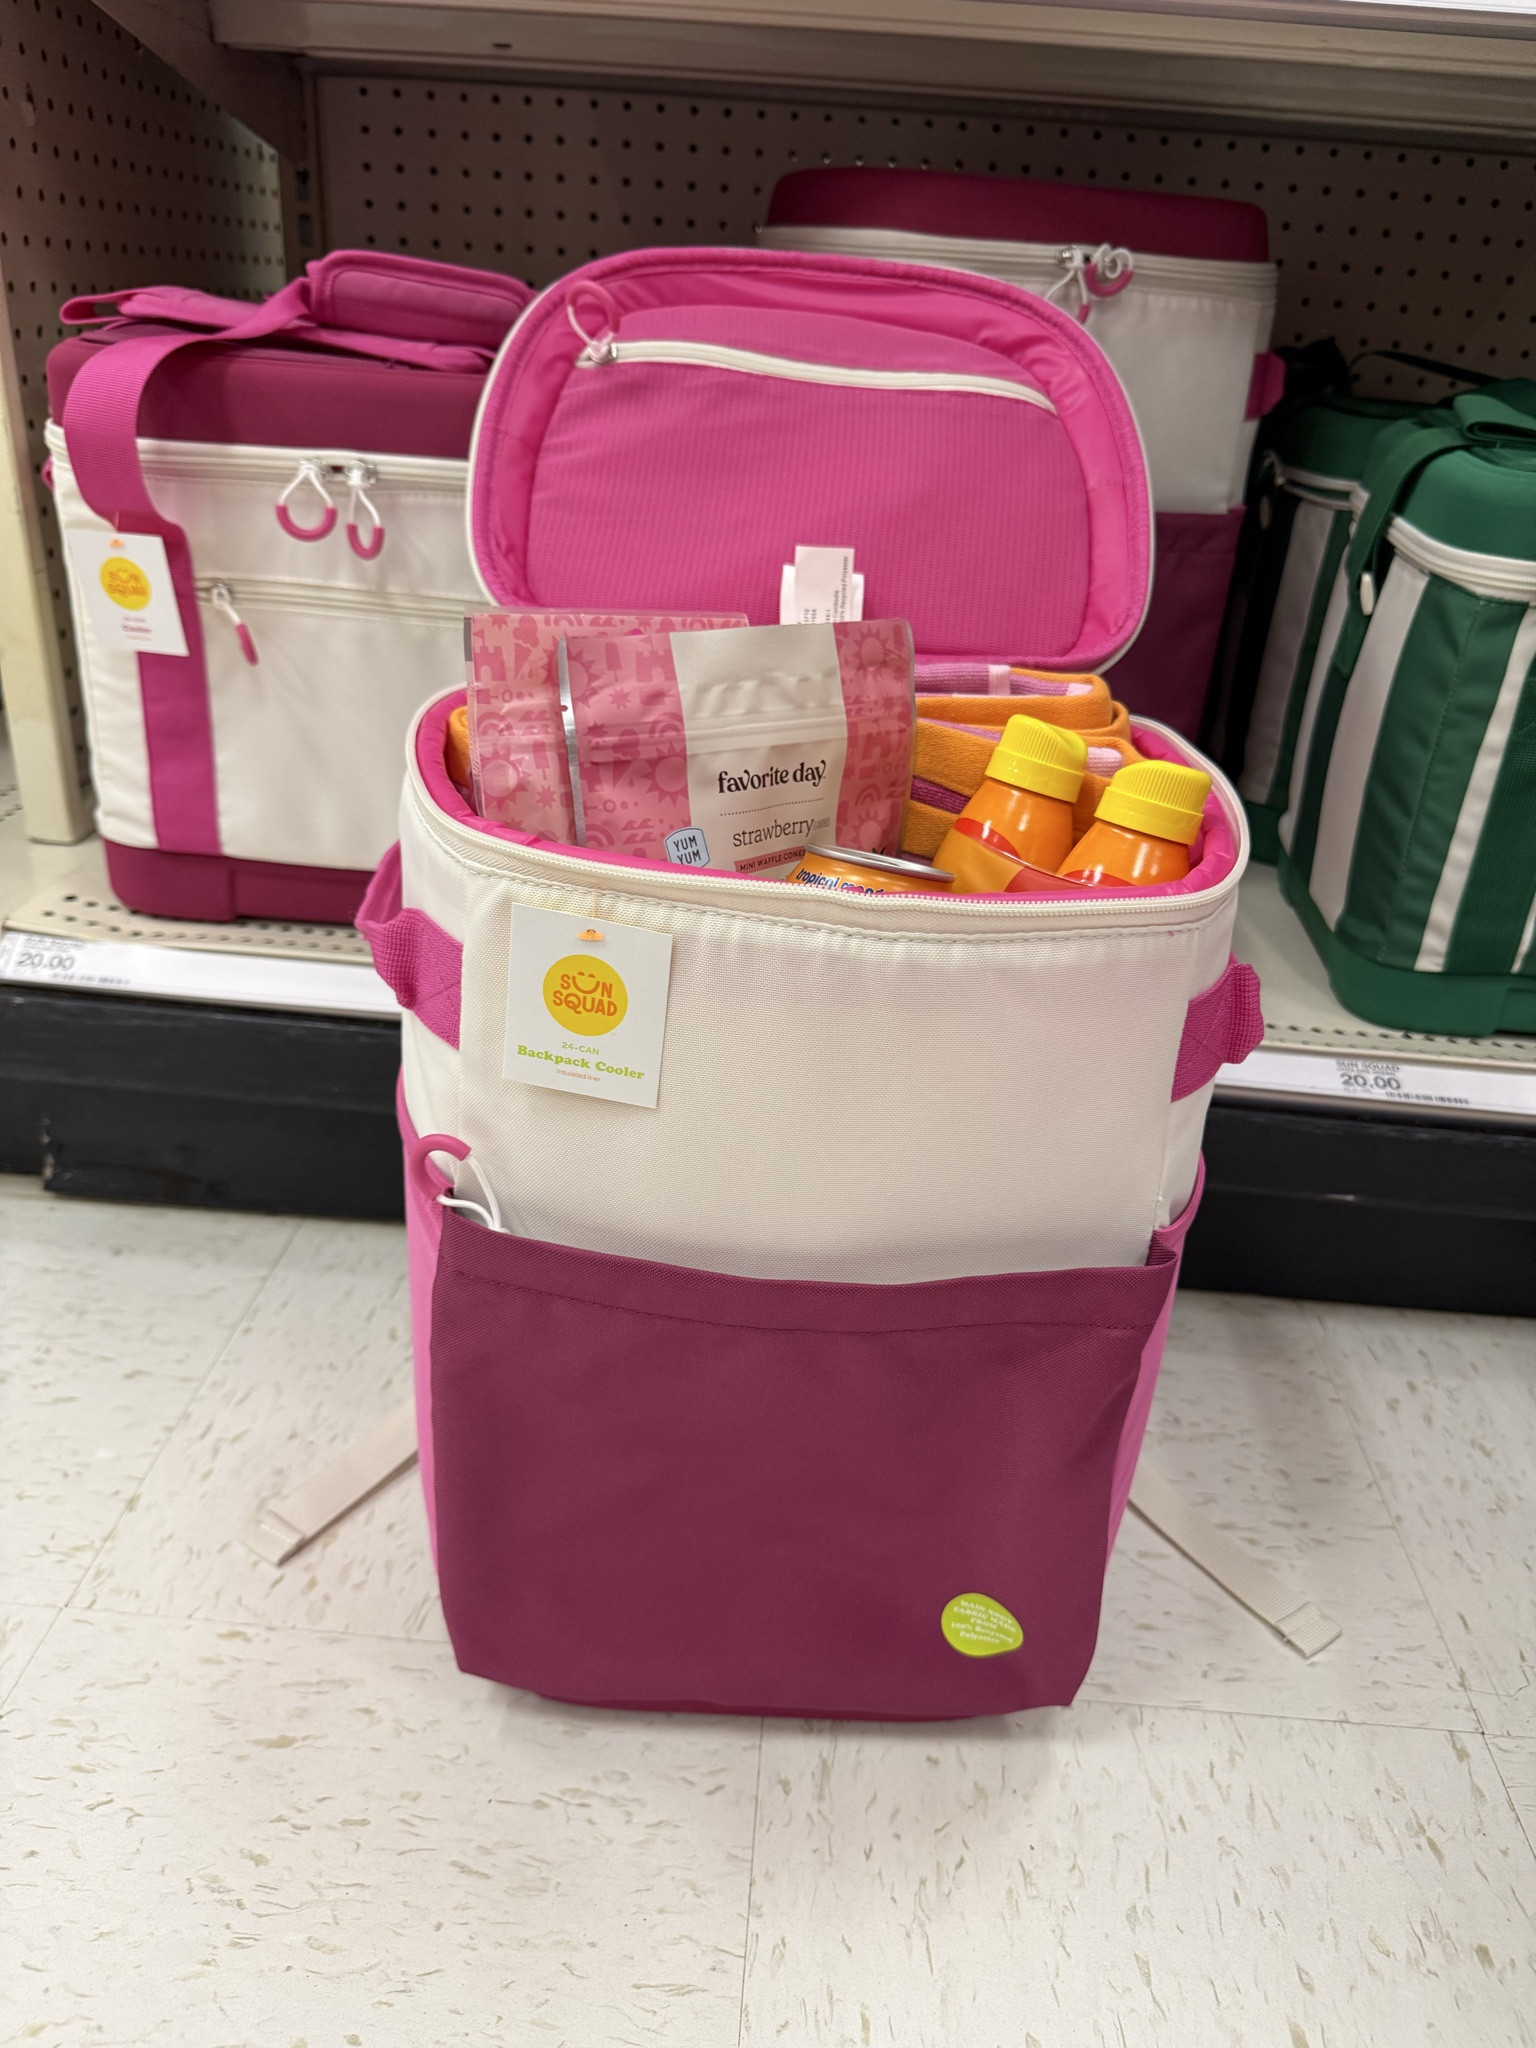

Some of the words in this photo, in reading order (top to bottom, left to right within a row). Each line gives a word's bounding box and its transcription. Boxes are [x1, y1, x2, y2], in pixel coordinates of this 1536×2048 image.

[717, 766, 789, 794] favorite
[792, 759, 827, 788] day
[732, 818, 815, 848] strawberry
[673, 835, 697, 852] YUM
[677, 849, 702, 865] YUM
[739, 862, 757, 872] MINI
[756, 855, 783, 868] WAFFLE
[782, 849, 806, 862] CONES
[796, 867, 840, 889] tropical
[17, 951, 76, 971] 20.00
[560, 972, 613, 999] SUN
[552, 990, 618, 1017] SQUAD
[561, 1041, 600, 1056] 24-CAN
[517, 1044, 591, 1070] Backpack
[595, 1061, 645, 1080] Cooler
[1340, 1072, 1401, 1091] 20.00
[953, 1606, 988, 1619] FABRIC
[960, 1600, 987, 1612] MAIN
[970, 1617, 998, 1629] FROM
[960, 1630, 1000, 1644] Polyester
